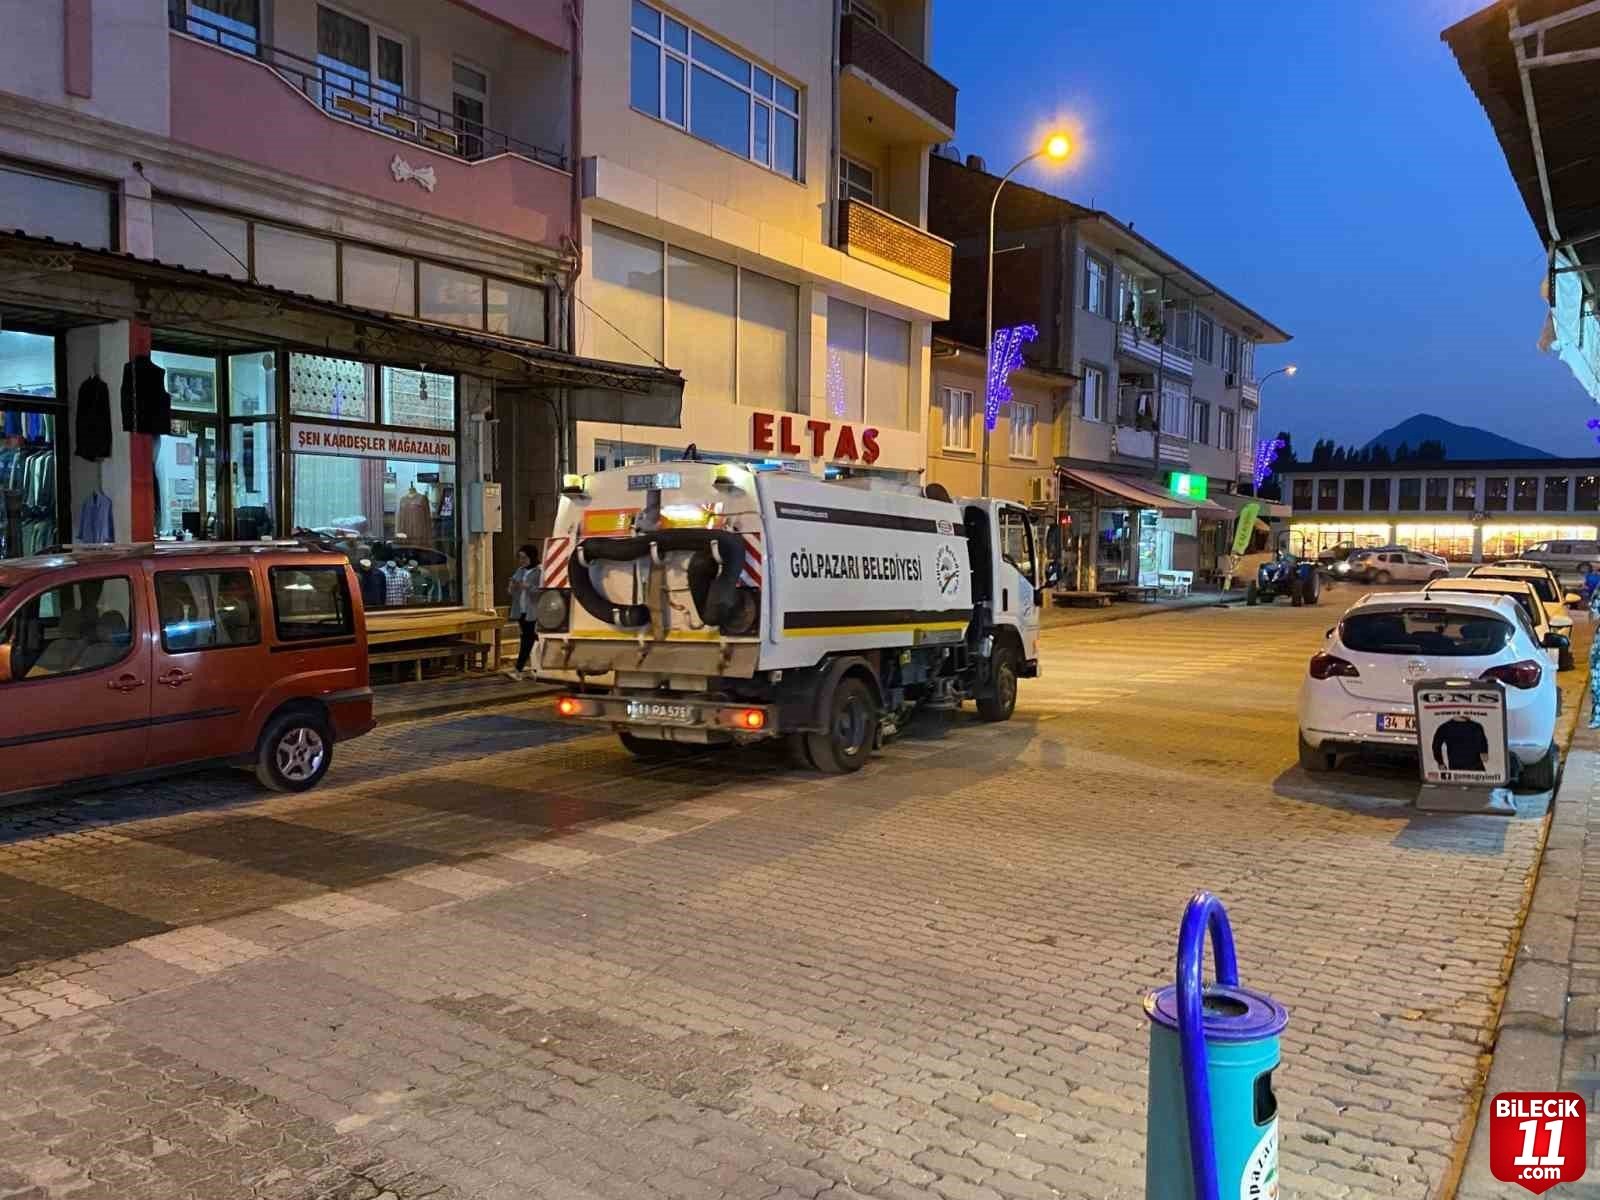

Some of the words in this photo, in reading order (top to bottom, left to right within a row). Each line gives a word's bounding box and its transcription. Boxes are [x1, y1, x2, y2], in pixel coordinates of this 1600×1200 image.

[299, 431, 320, 447] ŞEN
[323, 433, 386, 452] KARDEŞLER
[388, 437, 451, 457] MAĞAZALARI
[790, 547, 860, 579] GÖLPAZARI
[863, 554, 923, 581] BELEDİYESİ
[1422, 693, 1500, 703] GNS
[1384, 716, 1398, 728] 34
